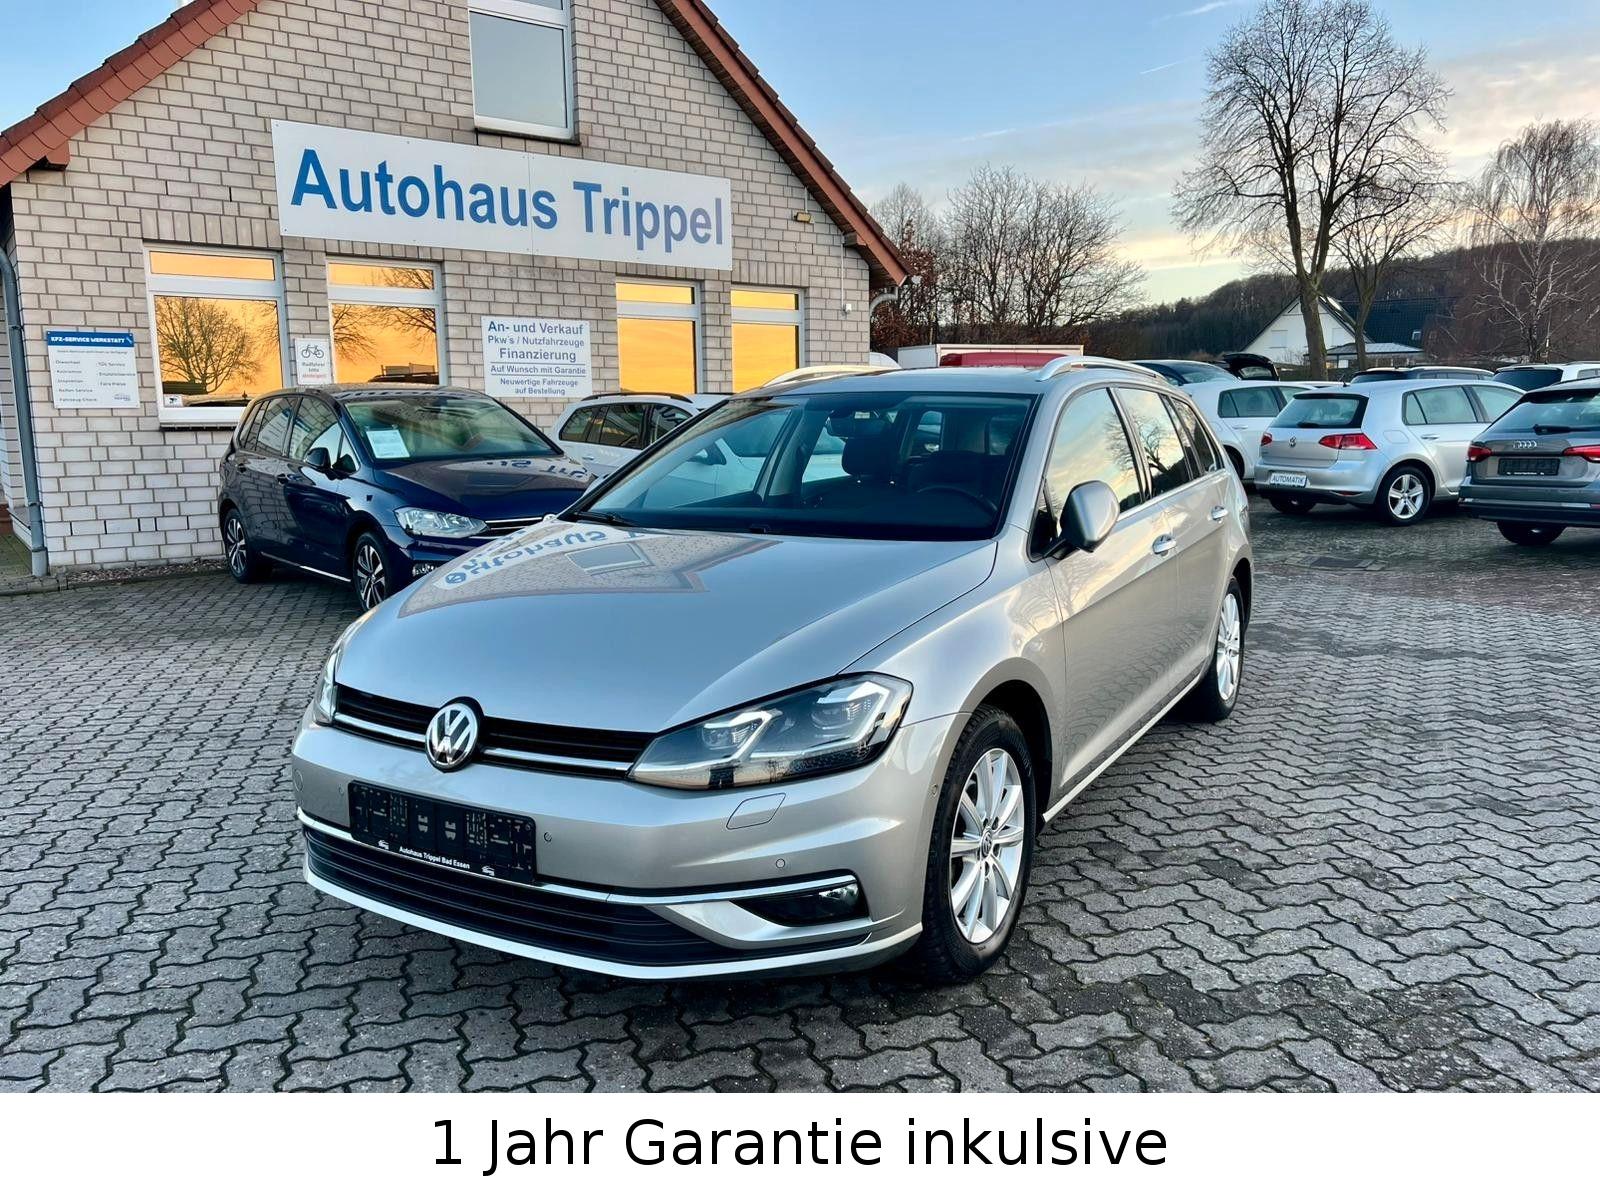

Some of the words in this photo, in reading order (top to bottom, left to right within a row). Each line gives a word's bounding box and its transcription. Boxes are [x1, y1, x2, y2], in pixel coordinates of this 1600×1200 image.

[290, 148, 558, 230] Autohaus
[573, 180, 723, 253] Trippel
[488, 321, 510, 332] An-
[513, 323, 536, 333] und
[540, 323, 584, 335] Verkauf
[522, 337, 585, 348] Nutzfahrzeuge
[499, 348, 577, 363] Finanzierung
[490, 365, 505, 373] Auf
[507, 365, 539, 374] Wunsch
[540, 366, 553, 374] mit
[554, 366, 586, 375] Garantie
[500, 378, 541, 387] Neuwertige
[542, 378, 579, 387] Fahrzeuge
[528, 387, 566, 396] Bestellung
[1272, 475, 1305, 485] AUTOMATIK
[399, 845, 423, 858] Autohaus
[423, 852, 441, 863] Trippel
[441, 856, 453, 865] Bad
[453, 859, 471, 870] Essen
